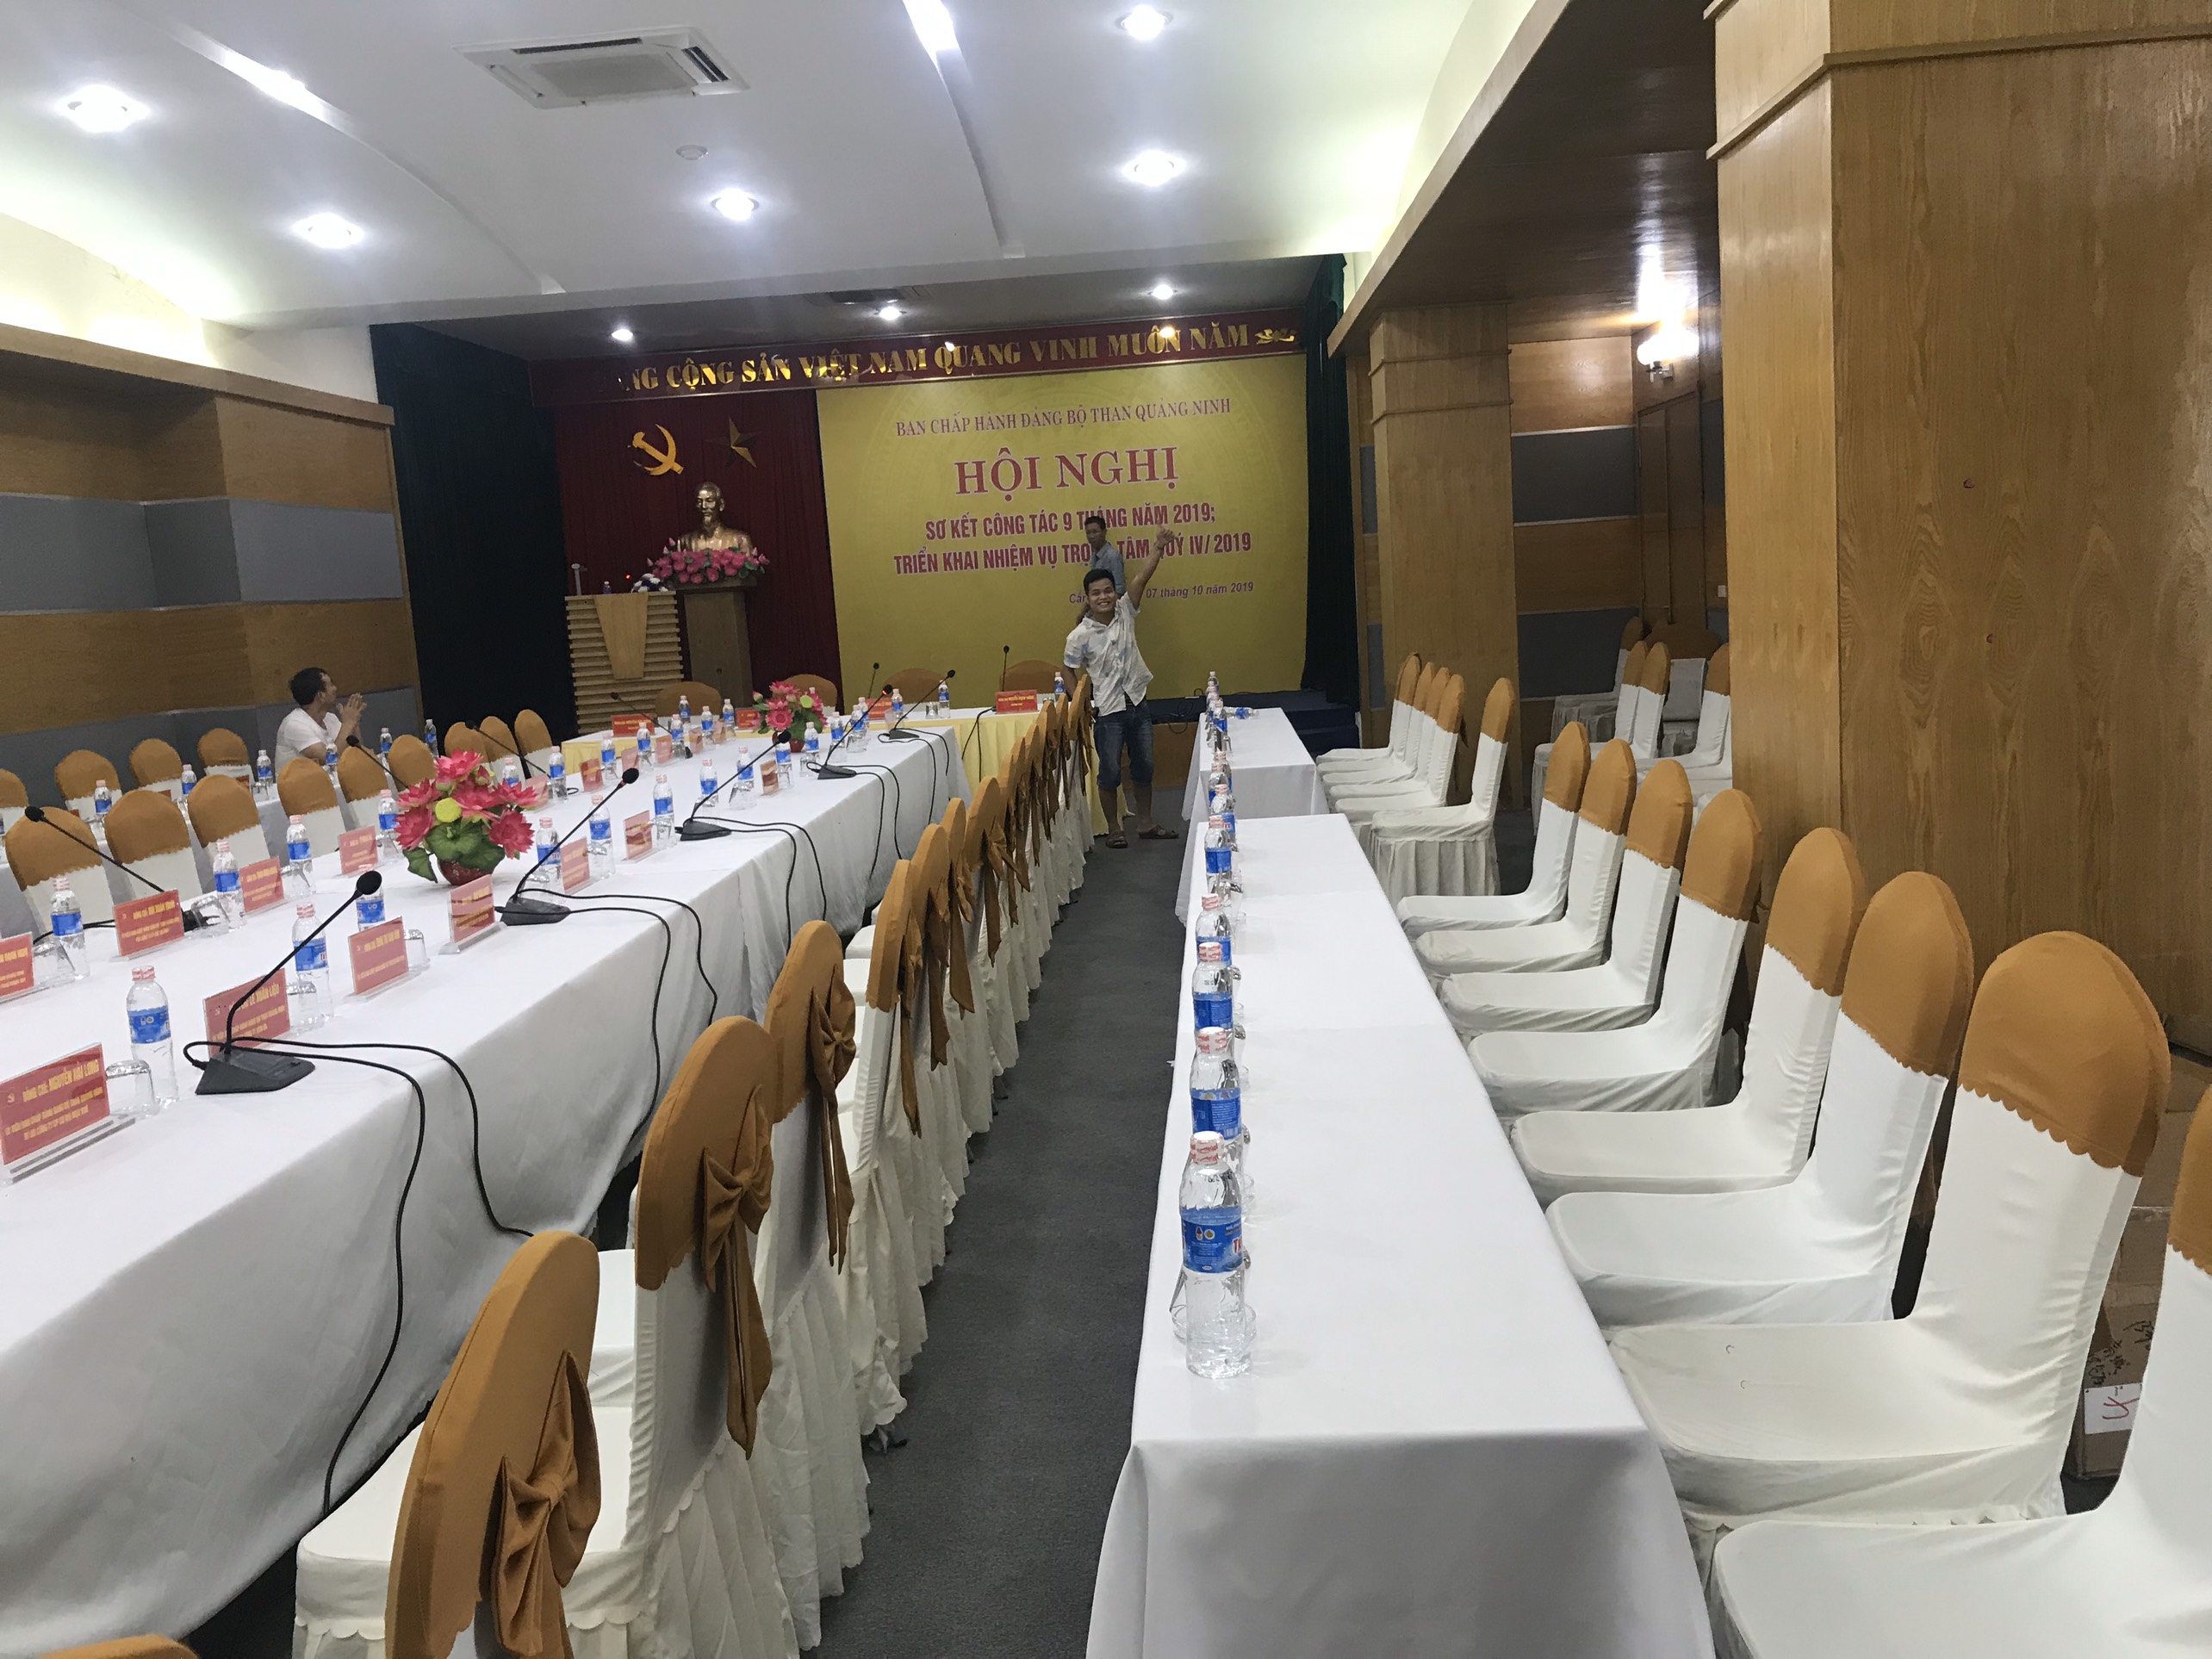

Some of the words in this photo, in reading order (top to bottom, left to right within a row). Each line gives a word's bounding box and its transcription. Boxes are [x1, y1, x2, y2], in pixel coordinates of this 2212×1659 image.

[666, 357, 734, 392] CỘNG
[742, 351, 792, 382] SẢN
[798, 347, 861, 382] VIỆT
[869, 347, 927, 374] NAM
[934, 341, 1021, 374] QUANG
[1030, 335, 1099, 363] VINH
[1190, 320, 1249, 351] NĂM
[896, 420, 927, 437] BAN
[930, 411, 971, 434] CHẤP
[974, 411, 1017, 432] HÀNH
[1021, 406, 1064, 428] ĐẢNG
[1066, 403, 1087, 428] BỘ
[1090, 405, 1132, 423] THAN
[1135, 397, 1189, 422] QUẢNG
[1192, 398, 1231, 416] NINH
[954, 446, 1042, 502] HỘI
[1054, 446, 1179, 490] NGHỊ
[925, 519, 948, 541] SƠ
[950, 511, 979, 539] KẾT
[983, 512, 1026, 537] CÔNG
[1029, 509, 1059, 534] TÁC
[1063, 512, 1073, 531] 9
[1132, 501, 1169, 527] NĂM
[1172, 502, 1216, 525] 2019;
[893, 545, 939, 575] TRIỂN
[942, 550, 980, 572] KHAI
[983, 543, 1035, 572] NHIỆM
[1037, 544, 1058, 569] VỤ
[1116, 536, 1150, 560] TÂM
[1146, 588, 1158, 599] 07
[1192, 585, 1203, 596] 10
[1206, 584, 1227, 595] năm
[1231, 581, 1254, 593] 2019
